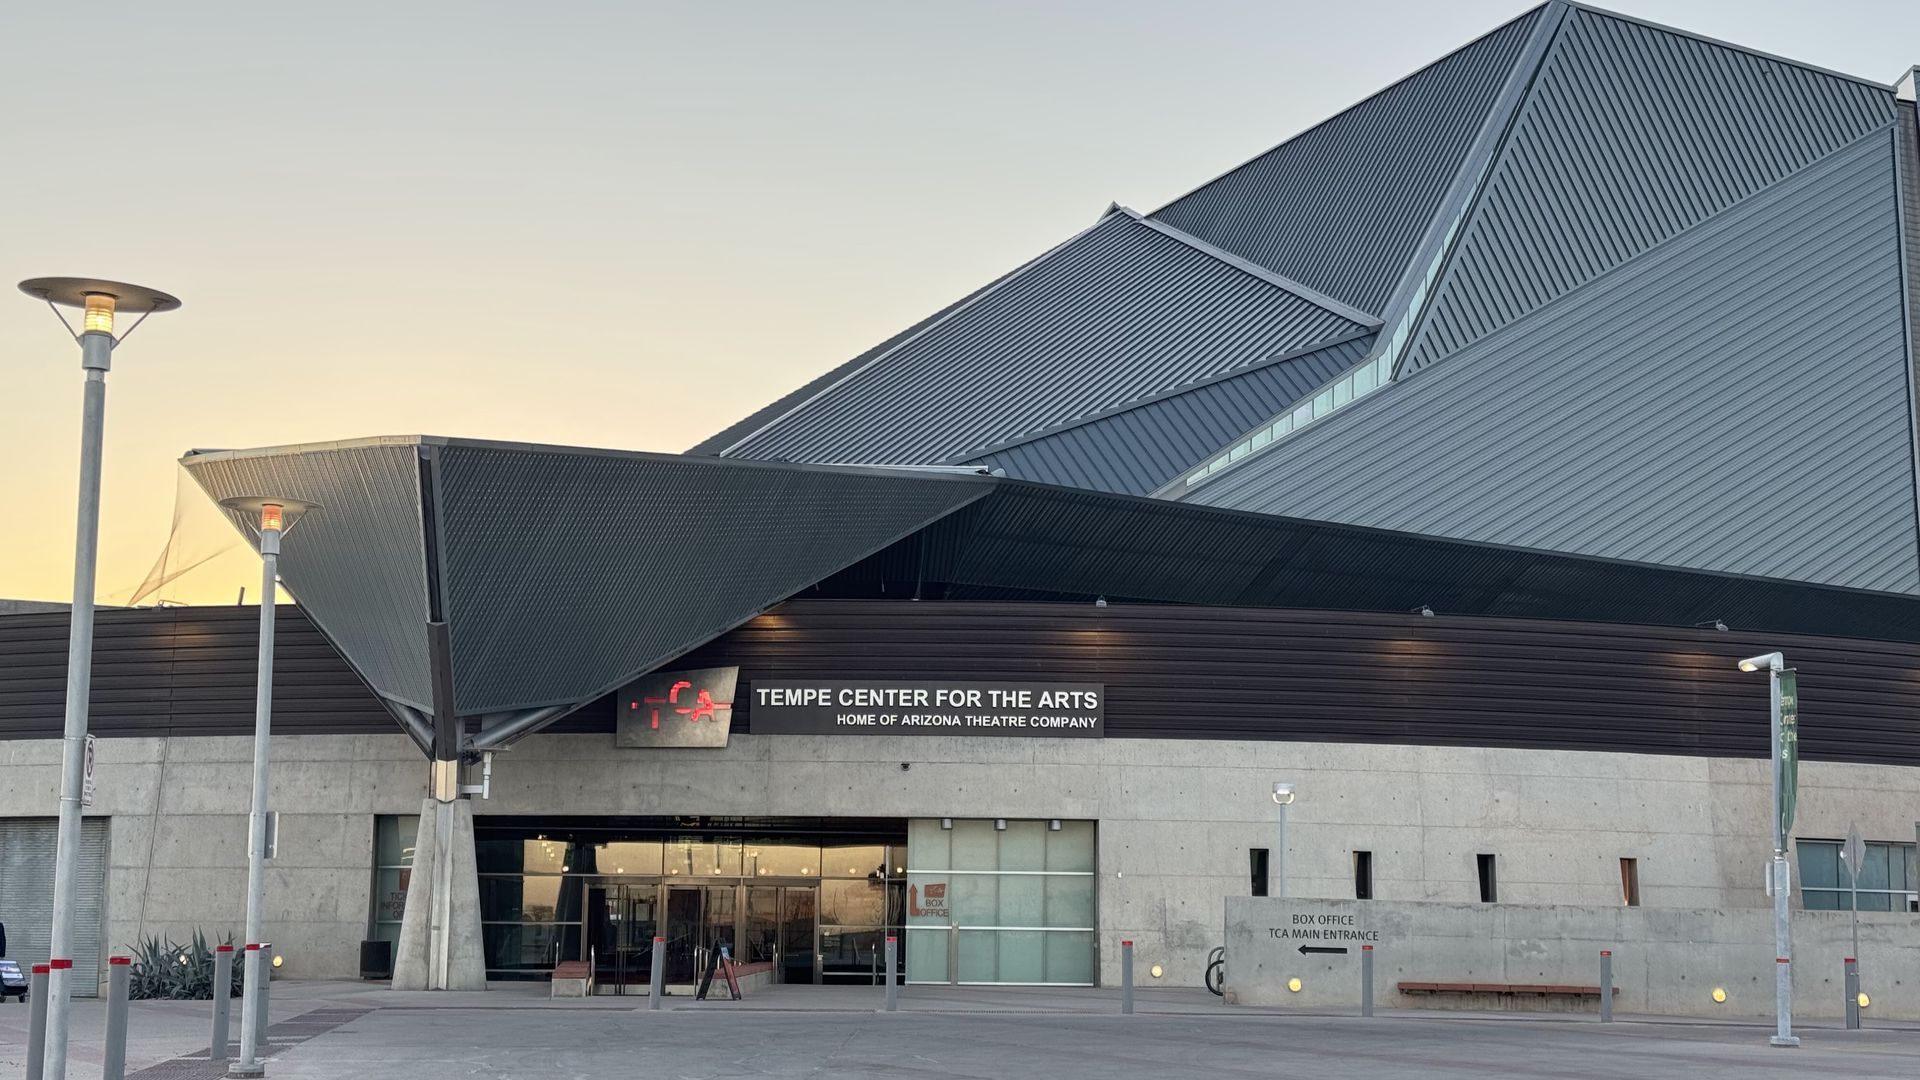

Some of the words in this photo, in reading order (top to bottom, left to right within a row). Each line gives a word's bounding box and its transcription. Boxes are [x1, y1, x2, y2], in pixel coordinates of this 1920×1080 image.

[756, 688, 832, 706] TEMPE
[838, 689, 929, 707] CENTER
[935, 689, 982, 707] FOR
[988, 690, 1032, 708] THE
[1038, 691, 1098, 709] ARTS
[837, 714, 876, 725] HOME
[879, 714, 898, 726] OF
[901, 715, 961, 726] ARIZONA
[965, 715, 1027, 727] THEATRE
[1030, 716, 1098, 728] COMPANY
[925, 898, 944, 908] BOX
[920, 908, 949, 917] OFFICE
[1292, 914, 1315, 925] BOX
[1318, 914, 1354, 926] OFFICE
[1268, 928, 1289, 939] TCA
[1292, 928, 1320, 940] MAIN
[1323, 929, 1379, 941] ENTRANCE
